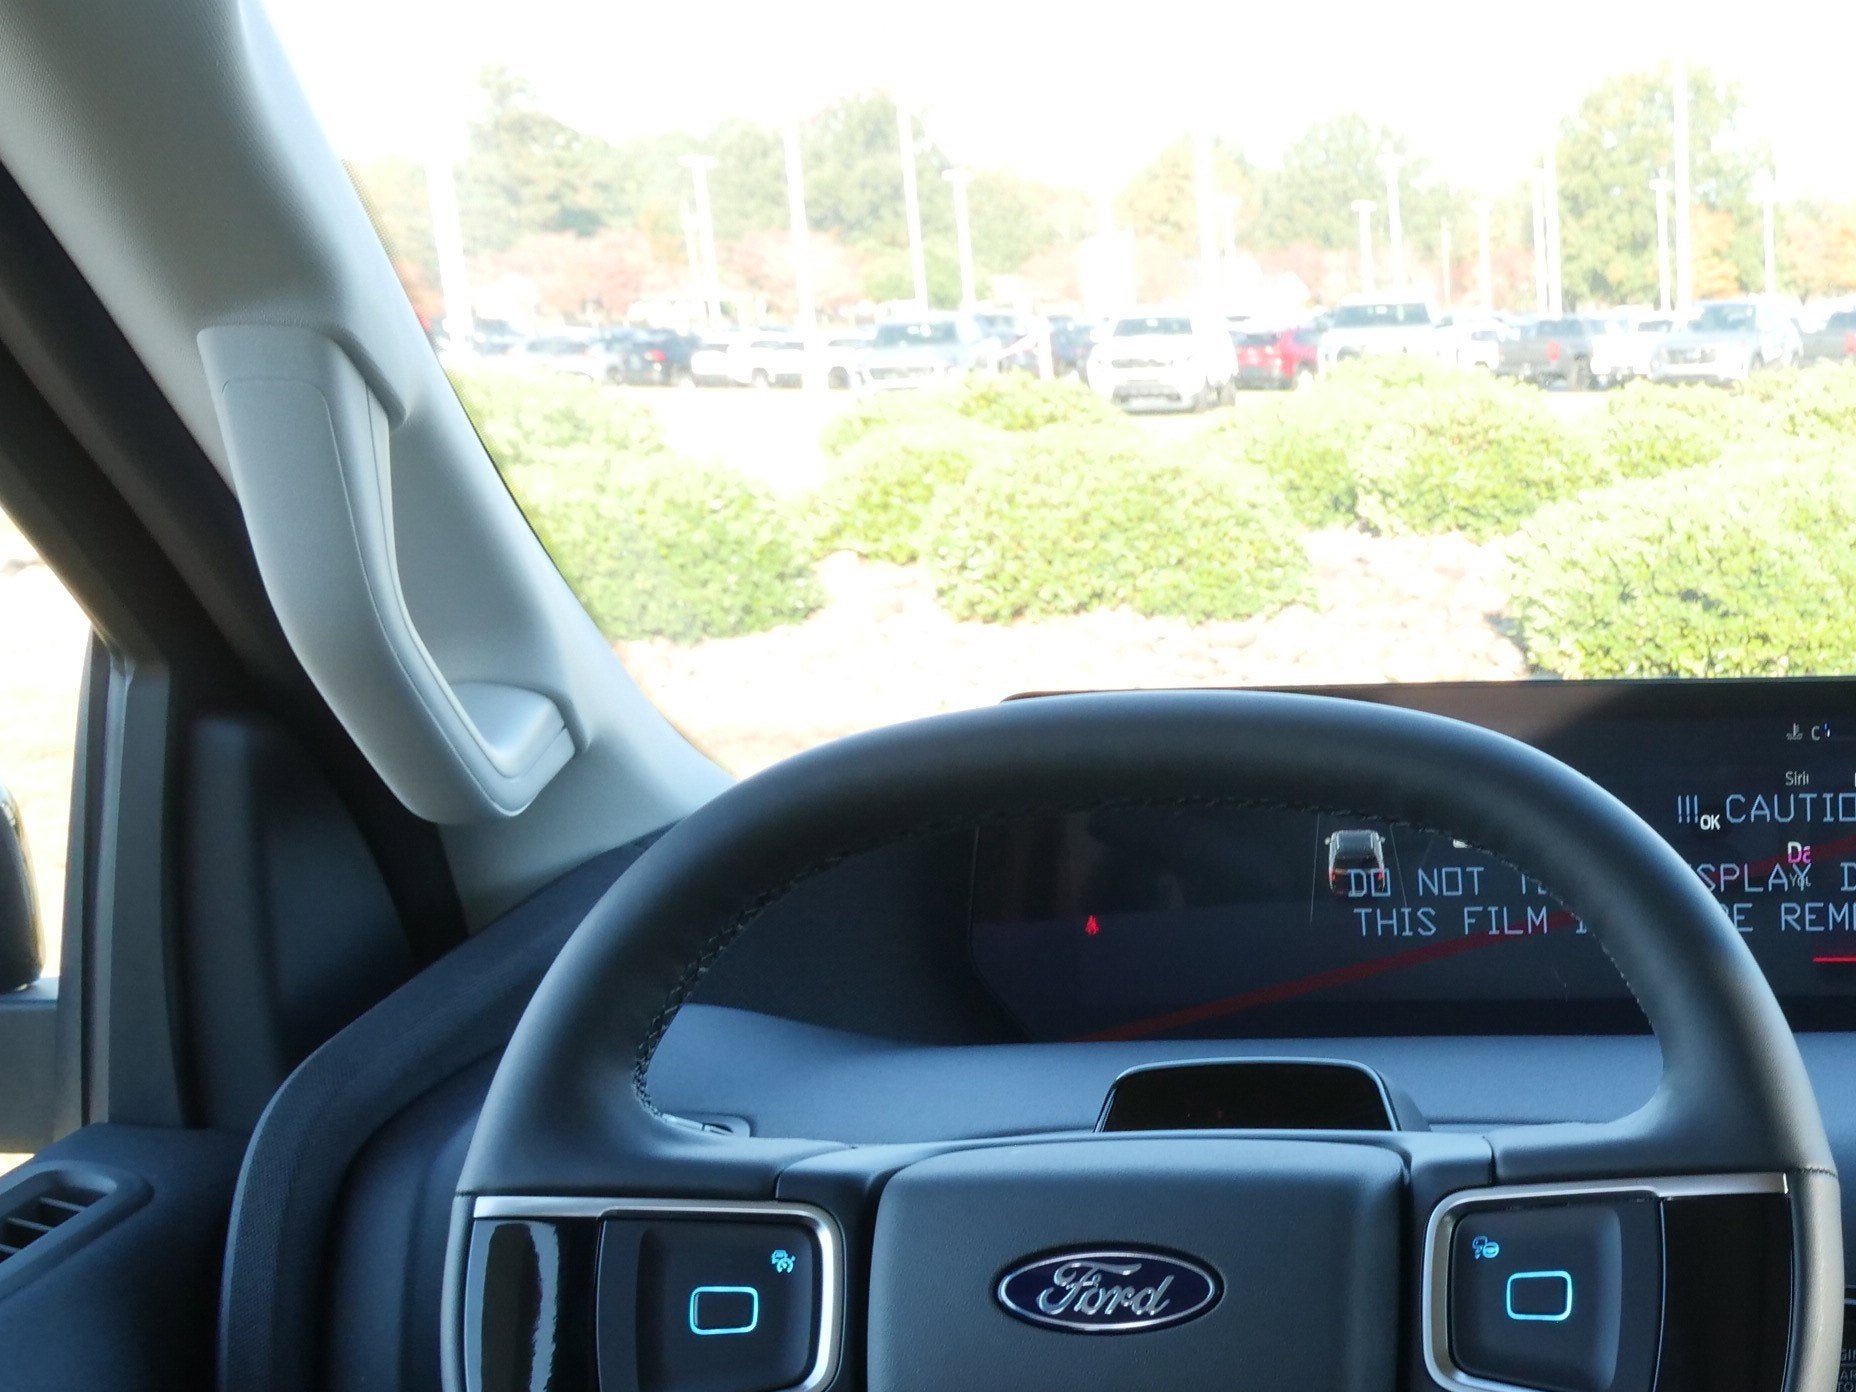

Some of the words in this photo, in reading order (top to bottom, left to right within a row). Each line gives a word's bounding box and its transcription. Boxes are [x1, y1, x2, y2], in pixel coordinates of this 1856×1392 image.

[1700, 814, 1721, 831] OK
[1348, 867, 1391, 897] DO
[1418, 866, 1485, 896] NOT
[1691, 862, 1812, 893] SPLAY
[1353, 906, 1437, 937] THIS
[1463, 905, 1548, 935] FILM
[1036, 1260, 1175, 1316] Ford
